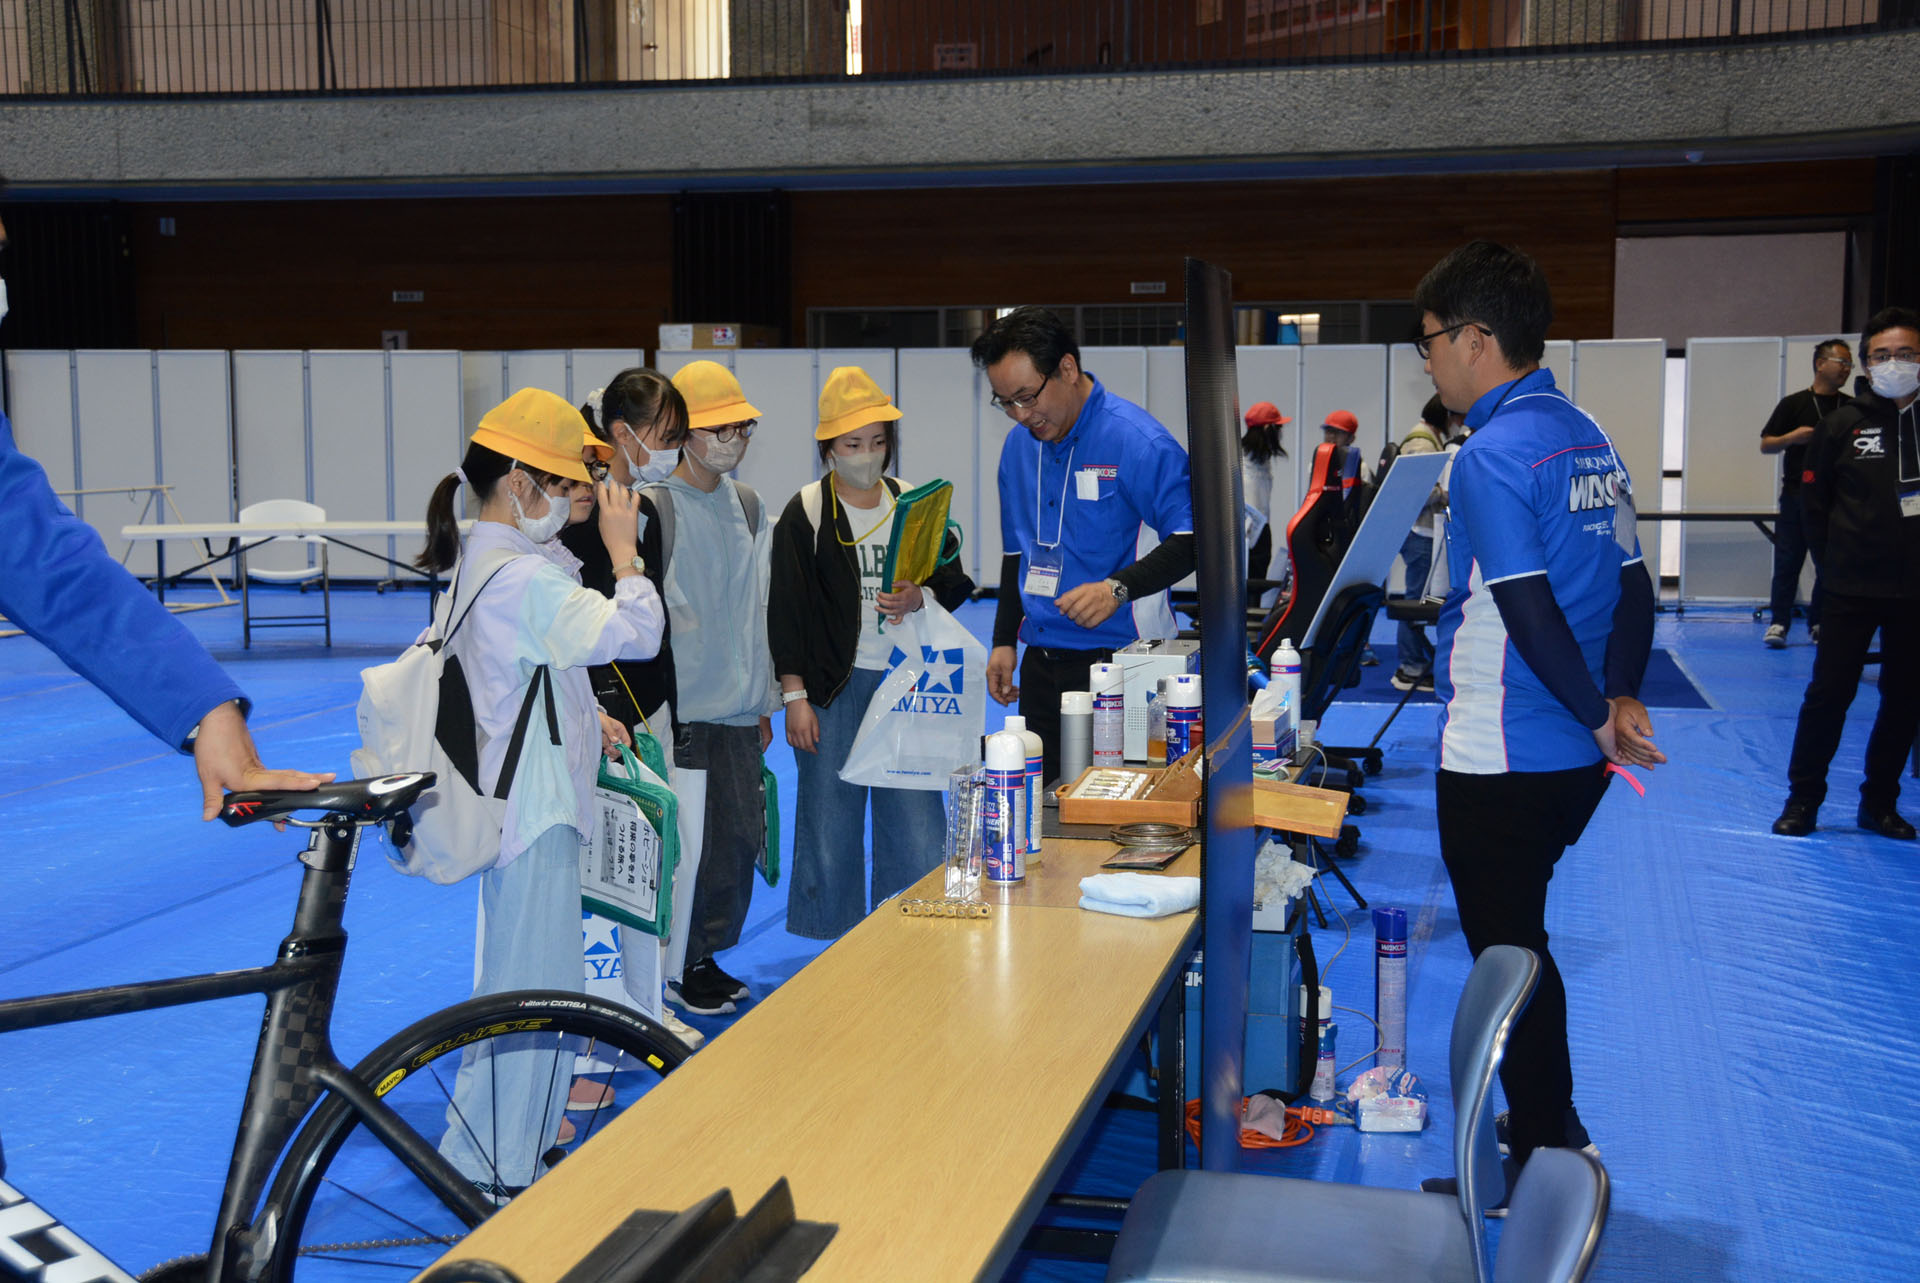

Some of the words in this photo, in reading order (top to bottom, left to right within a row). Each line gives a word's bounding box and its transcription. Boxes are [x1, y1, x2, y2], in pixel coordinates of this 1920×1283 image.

[890, 696, 963, 715] MIYA
[585, 957, 624, 980] YA
[550, 1000, 587, 1010] CORSA
[380, 1073, 401, 1093] MAVIC
